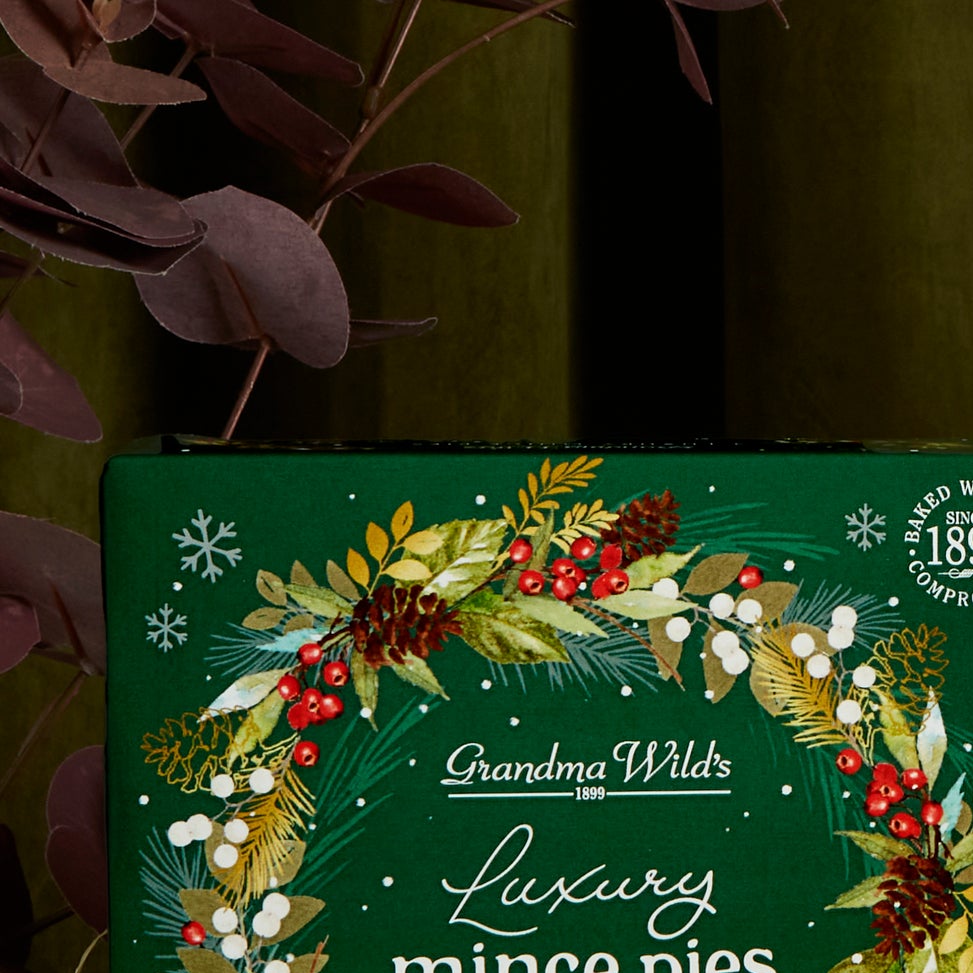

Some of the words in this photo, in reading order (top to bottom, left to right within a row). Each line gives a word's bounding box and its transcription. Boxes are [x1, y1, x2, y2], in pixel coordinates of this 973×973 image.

[904, 485, 950, 543] BAKED
[440, 743, 606, 785] Grandma
[612, 740, 732, 783] Wild's
[575, 787, 606, 800] 1899
[441, 824, 716, 940] Luxury
